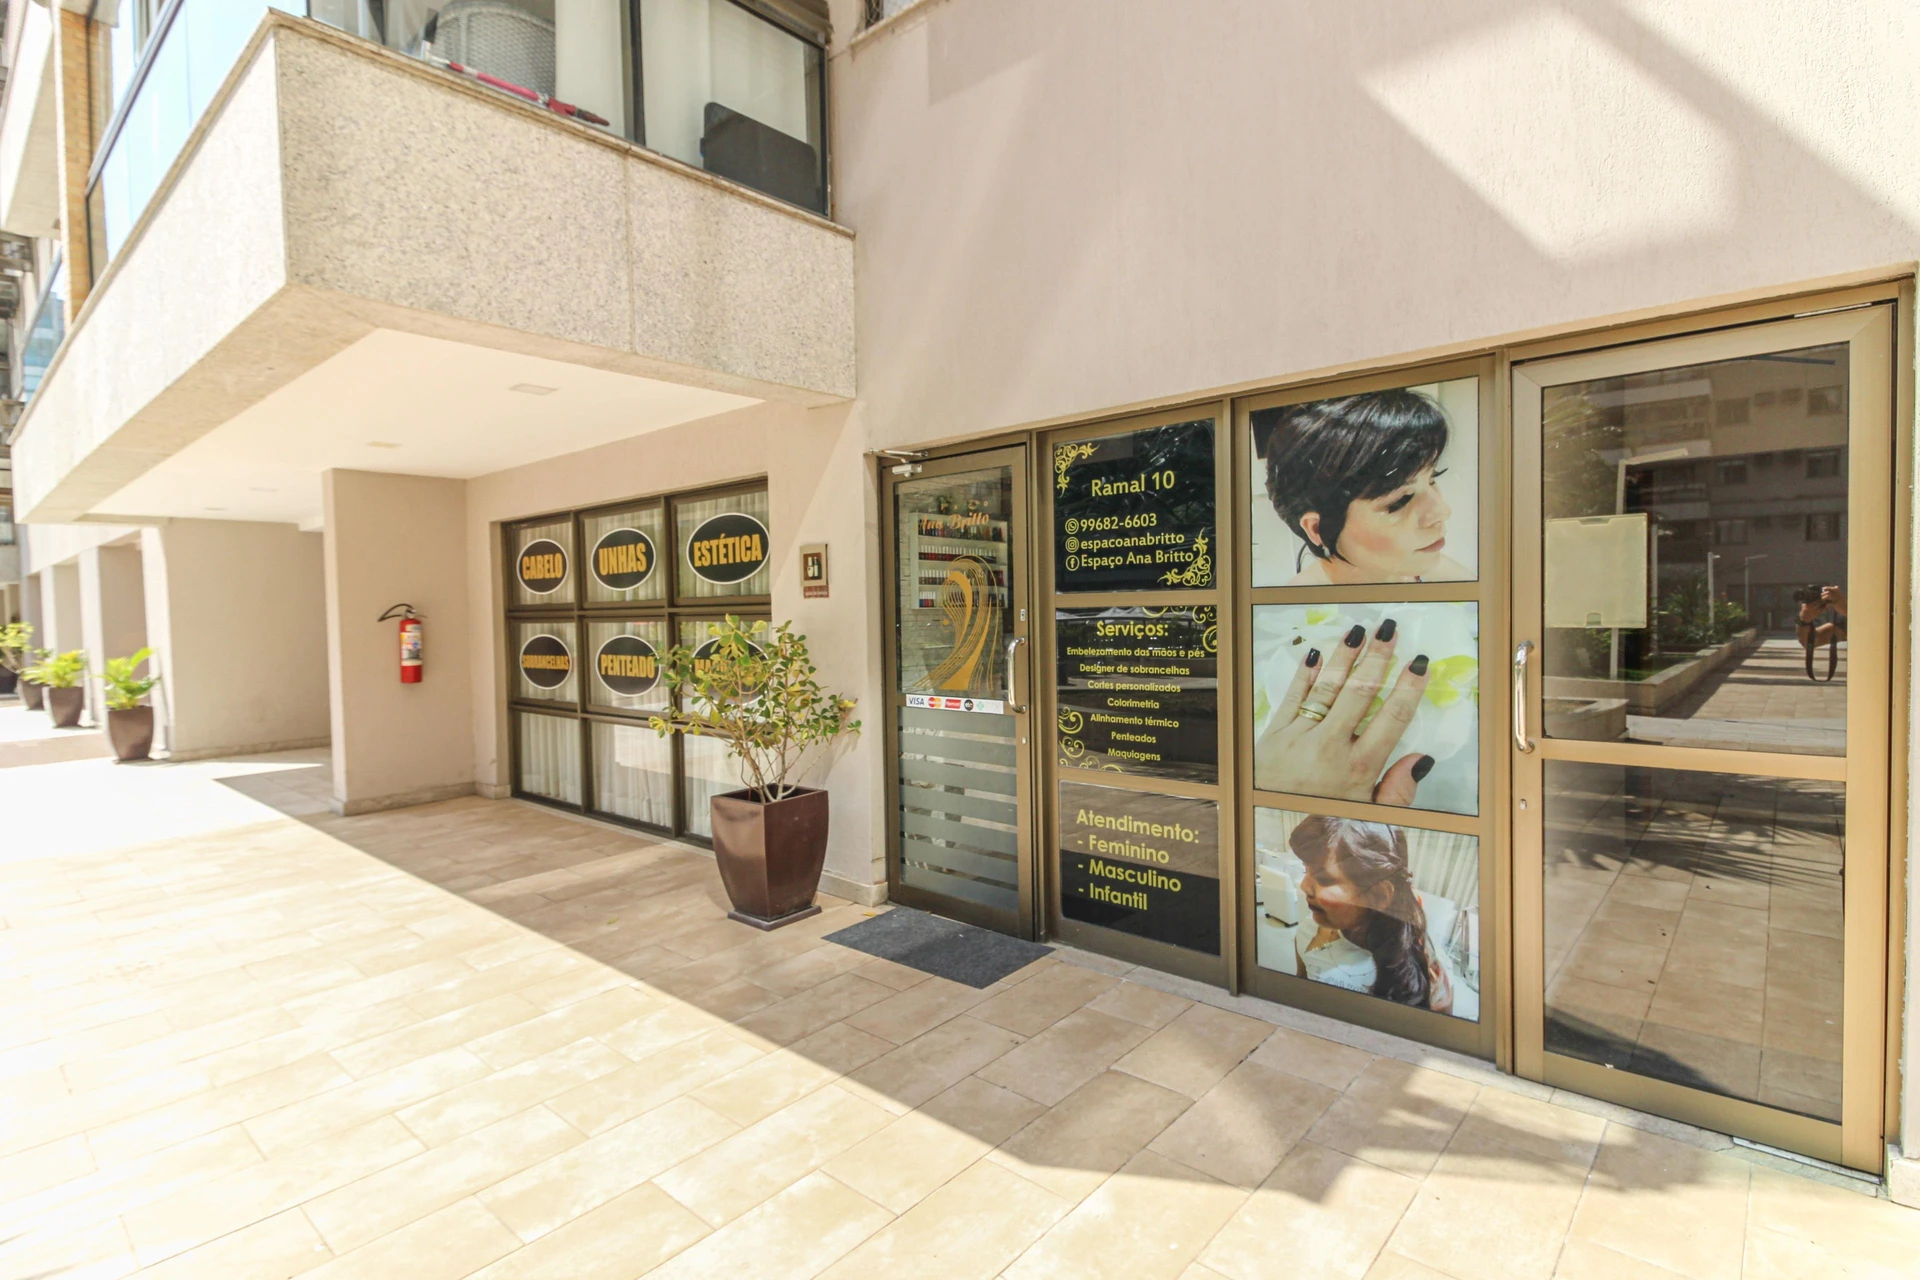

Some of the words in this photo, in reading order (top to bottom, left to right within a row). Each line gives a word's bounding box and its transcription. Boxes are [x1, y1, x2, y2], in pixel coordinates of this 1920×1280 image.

[1091, 474, 1145, 497] Ramal
[1151, 470, 1175, 490] 10
[949, 512, 990, 530] Britto
[1080, 513, 1157, 532] 99682-6603
[693, 533, 762, 567] ESTÉTICA
[1080, 532, 1185, 552] espacoanabritto
[522, 553, 563, 580] CABELO
[599, 542, 647, 576] UNHAS
[1081, 554, 1123, 570] Espaço
[1126, 551, 1152, 565] Ana
[1156, 550, 1194, 564] Britto
[1096, 620, 1169, 639] Serviços:
[1067, 647, 1131, 657] Embelezamento
[1134, 647, 1150, 657] das
[1152, 648, 1177, 657] mãos
[1187, 648, 1205, 659] pés
[600, 653, 656, 679] PENTEADO
[1079, 663, 1115, 674] Designer
[1116, 664, 1128, 673] de
[1130, 665, 1190, 675] sobrancelhas
[1087, 680, 1114, 690] Cortes
[1115, 683, 1181, 693] personalizados
[909, 697, 925, 706] VISA
[1107, 698, 1160, 709] Colorimetria
[1090, 713, 1143, 725] Alinhamento
[1145, 717, 1180, 728] térmico
[1111, 731, 1157, 744] Penteados
[1107, 748, 1161, 762] Maquiagens
[1076, 809, 1200, 844] Atendimento:
[1089, 834, 1170, 864] Feminino
[1089, 859, 1182, 892] Masculino
[1089, 882, 1148, 911] Infantil
